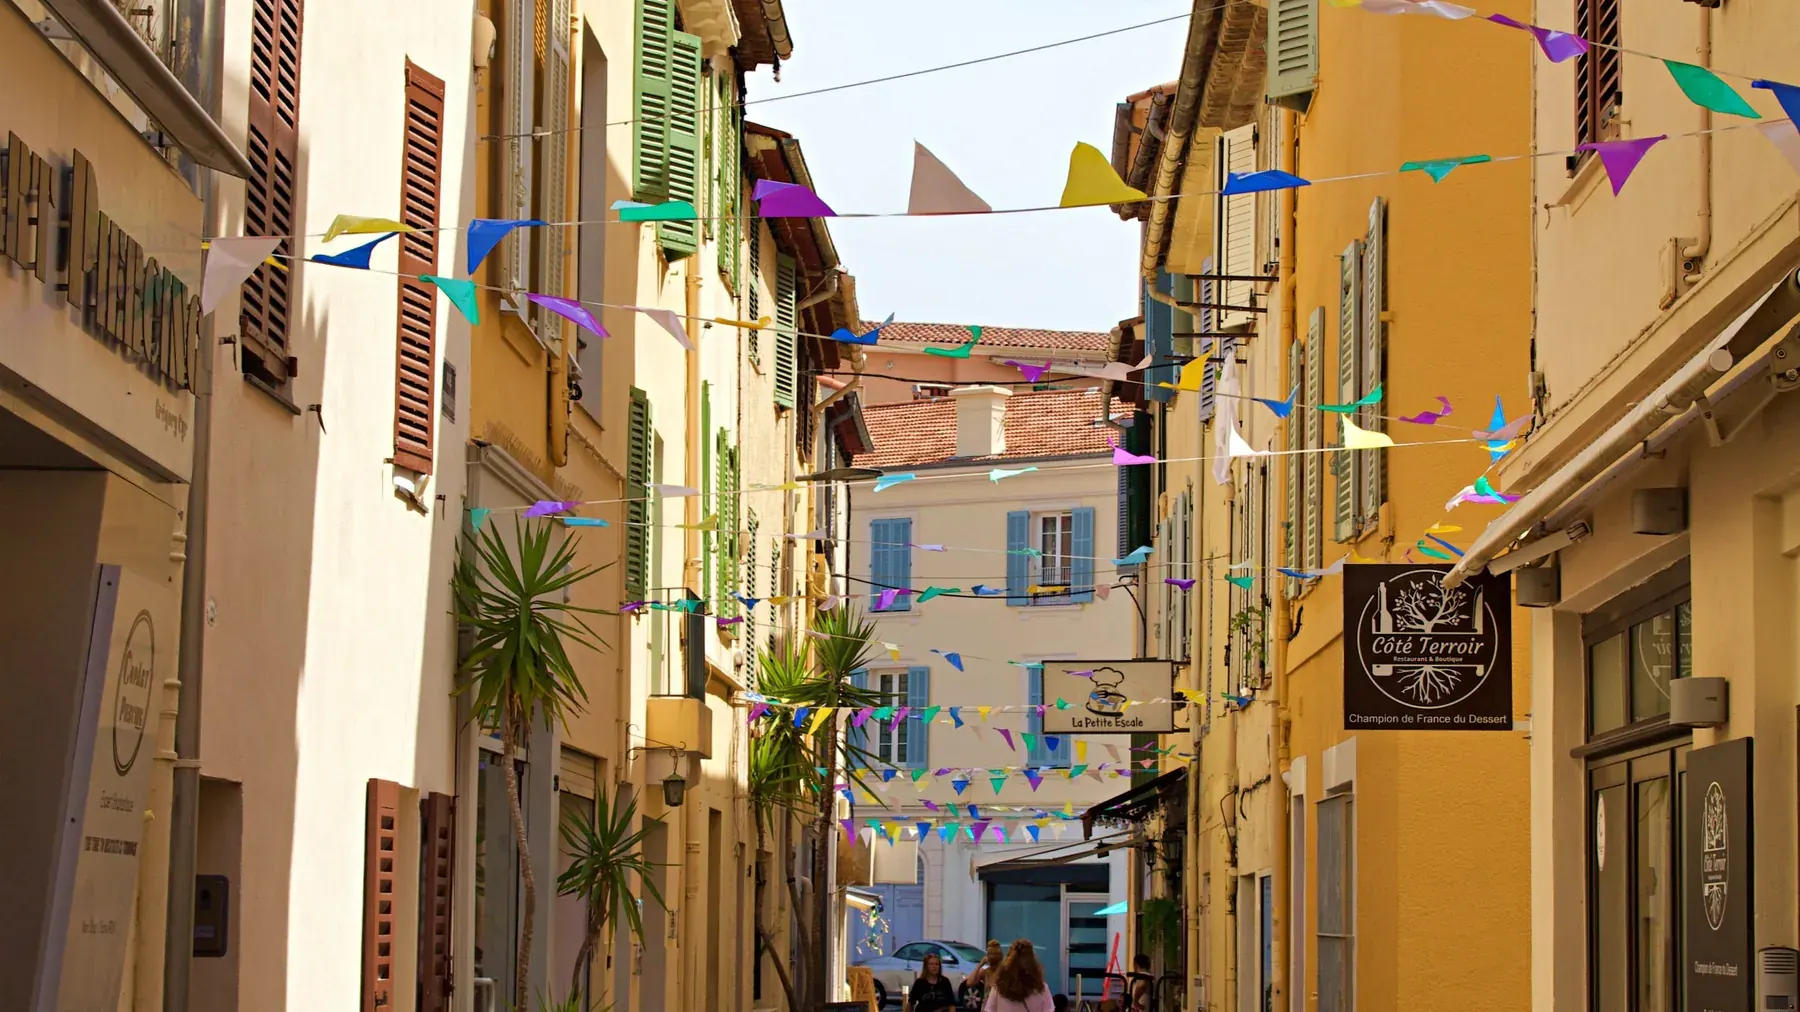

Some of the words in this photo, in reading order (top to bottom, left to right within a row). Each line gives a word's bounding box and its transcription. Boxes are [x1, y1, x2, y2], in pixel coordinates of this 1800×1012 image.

[1372, 636, 1413, 655] Côté
[1419, 636, 1485, 655] Terroir
[1434, 656, 1464, 664] Boutique
[1072, 717, 1083, 728] La
[1085, 717, 1113, 728] Petite
[1115, 717, 1144, 727] Escale
[1349, 713, 1399, 725] Champion
[1401, 713, 1414, 724] de
[1416, 713, 1451, 724] France
[1453, 713, 1466, 724] du
[1468, 713, 1508, 724] Dessert
